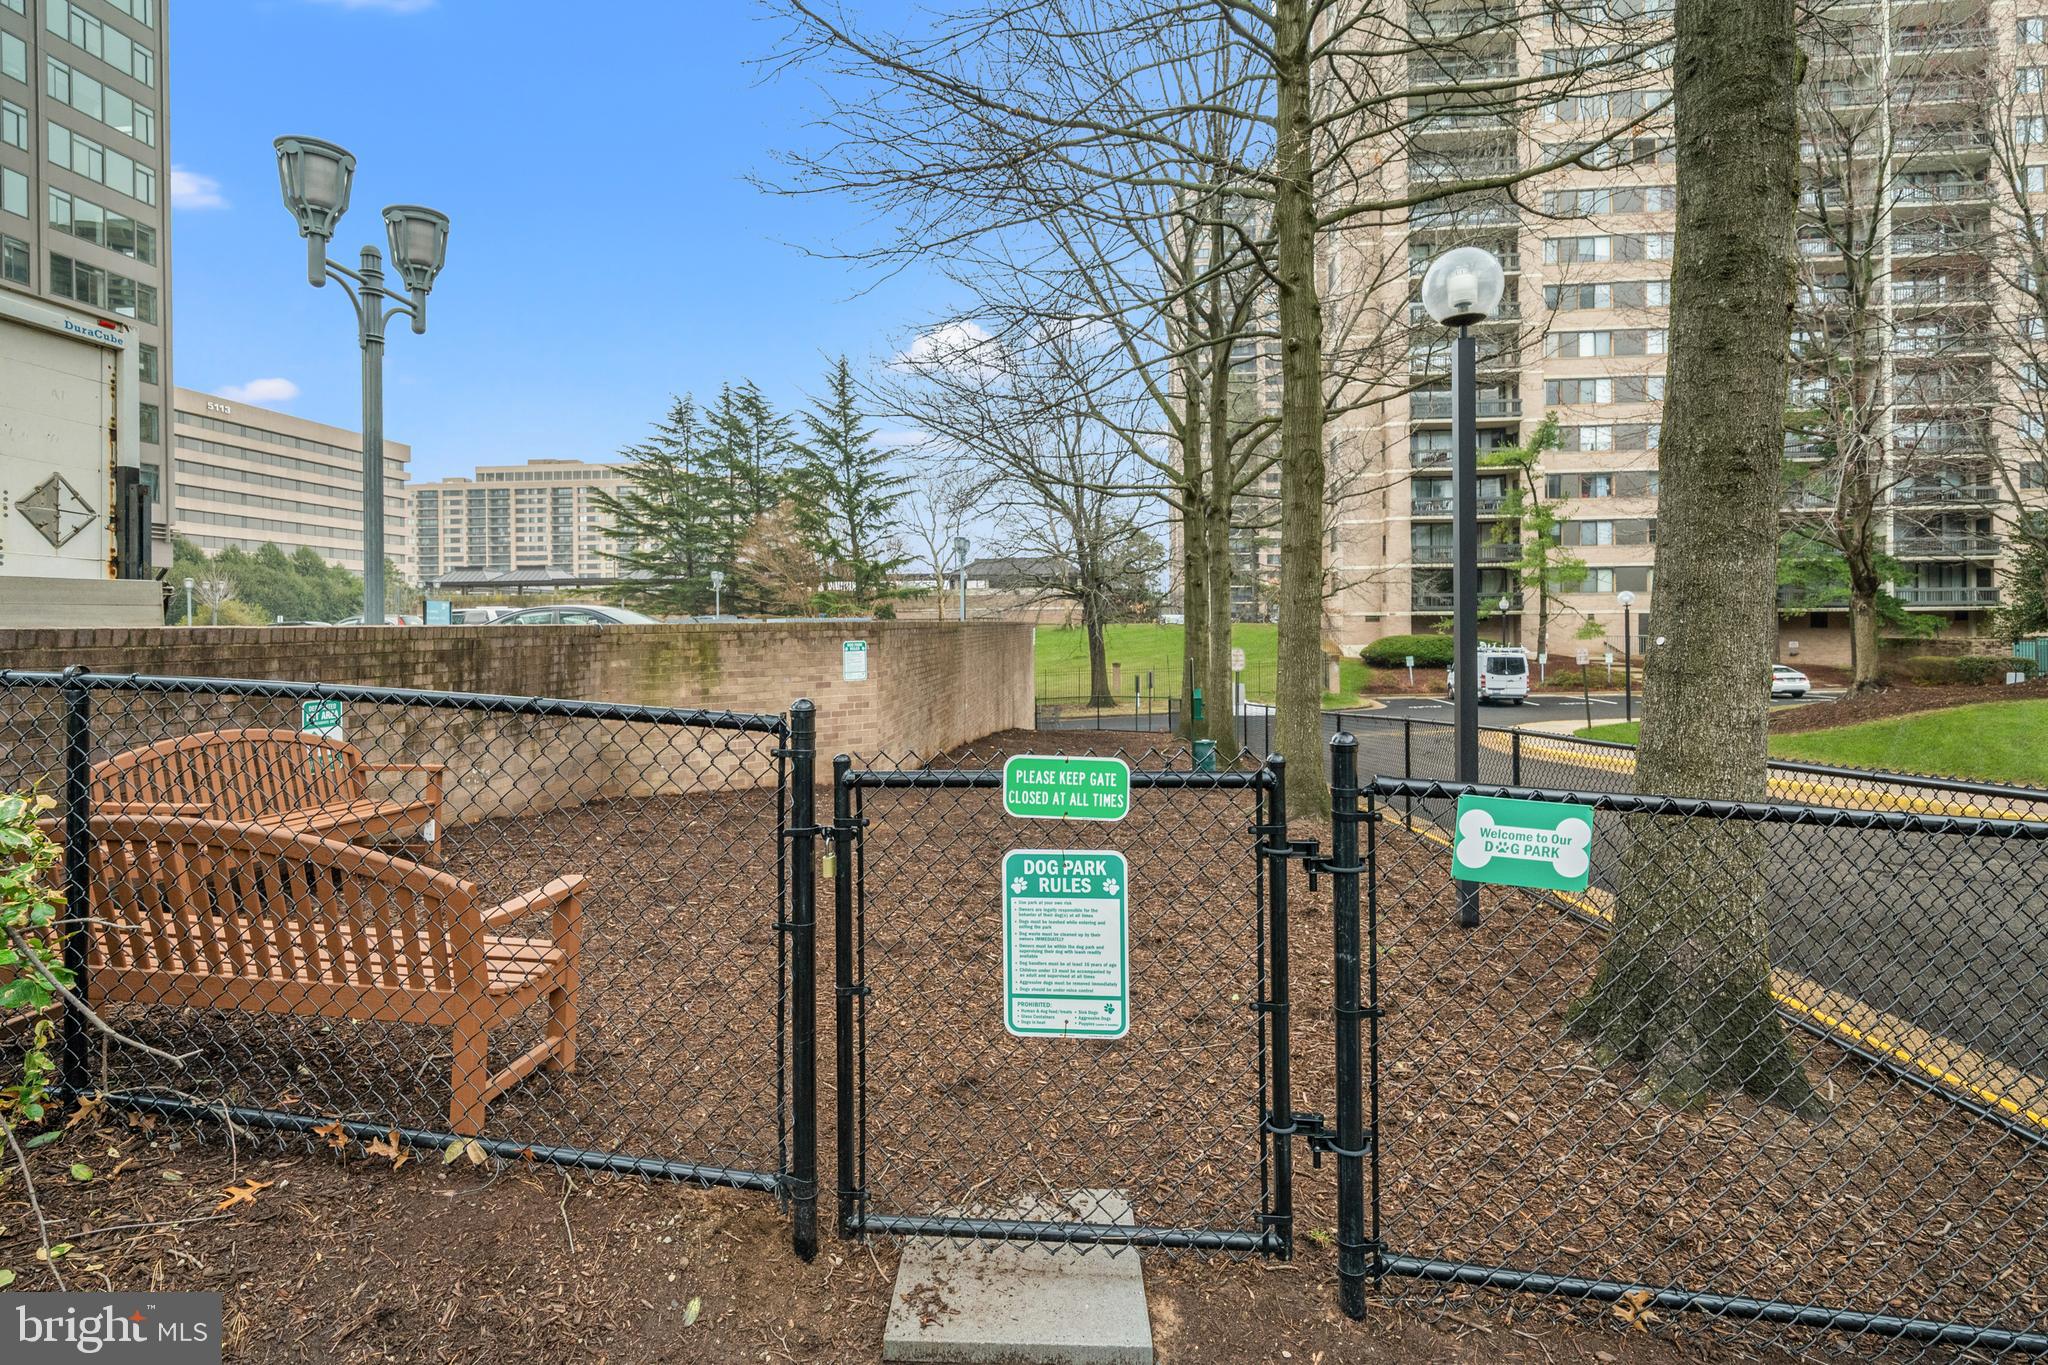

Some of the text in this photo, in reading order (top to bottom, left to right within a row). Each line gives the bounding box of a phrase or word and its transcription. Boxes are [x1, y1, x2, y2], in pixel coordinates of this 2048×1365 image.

[64, 320, 123, 345] DuraCube
[207, 401, 231, 414] 5113
[1016, 770, 1117, 787] PLEASE KEEP GATE
[1008, 791, 1124, 808] CLOSED AT ALL TIMES
[1480, 827, 1572, 845] Welcome to Our
[1523, 844, 1560, 858] PARK
[1023, 859, 1107, 876] DOG PARK
[1039, 877, 1092, 893] RULES
